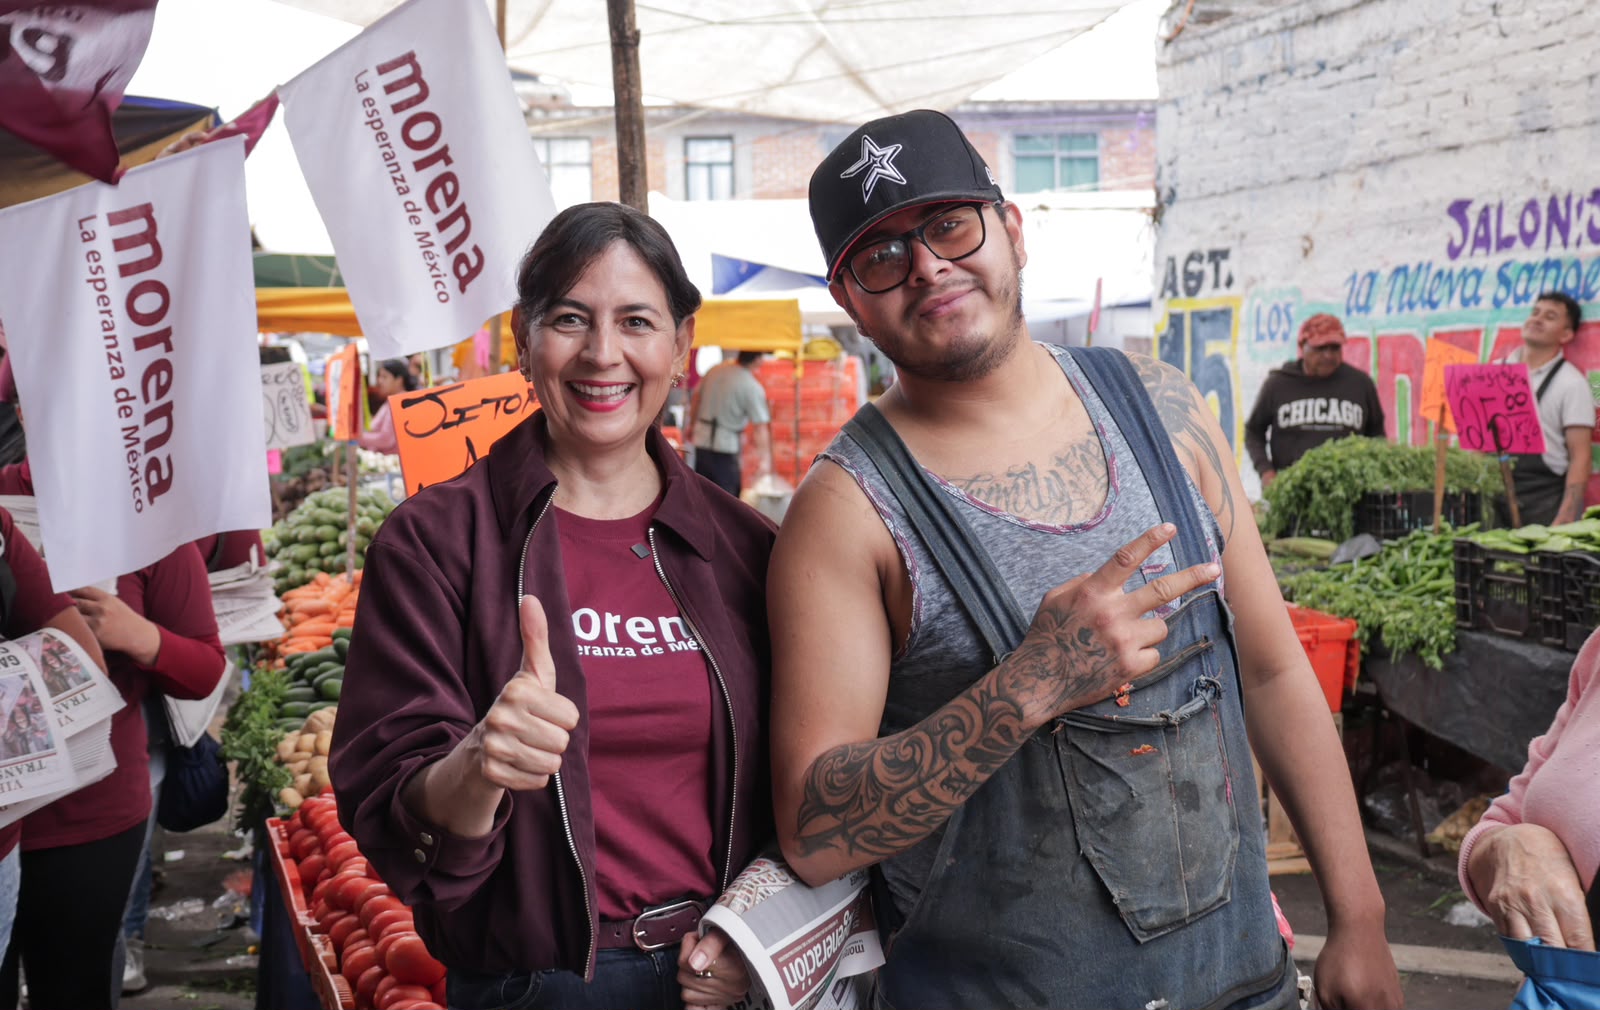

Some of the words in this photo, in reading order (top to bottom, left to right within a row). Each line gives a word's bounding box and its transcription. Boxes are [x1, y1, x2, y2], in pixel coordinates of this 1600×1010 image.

[354, 69, 370, 93] La
[362, 97, 411, 196] esperanza
[403, 200, 422, 225] de
[414, 231, 450, 303] México
[376, 50, 485, 295] morena
[78, 214, 97, 243] La
[86, 250, 126, 380] esperanza
[1255, 303, 1295, 343] LOS
[107, 202, 174, 506] morena
[114, 387, 137, 419] de
[1278, 397, 1363, 429] CHICAGO
[121, 425, 143, 514] México
[571, 607, 696, 645] oren
[0, 654, 20, 669] GA
[577, 643, 637, 657] eranza
[640, 645, 664, 656] de
[669, 637, 702, 653] Mé
